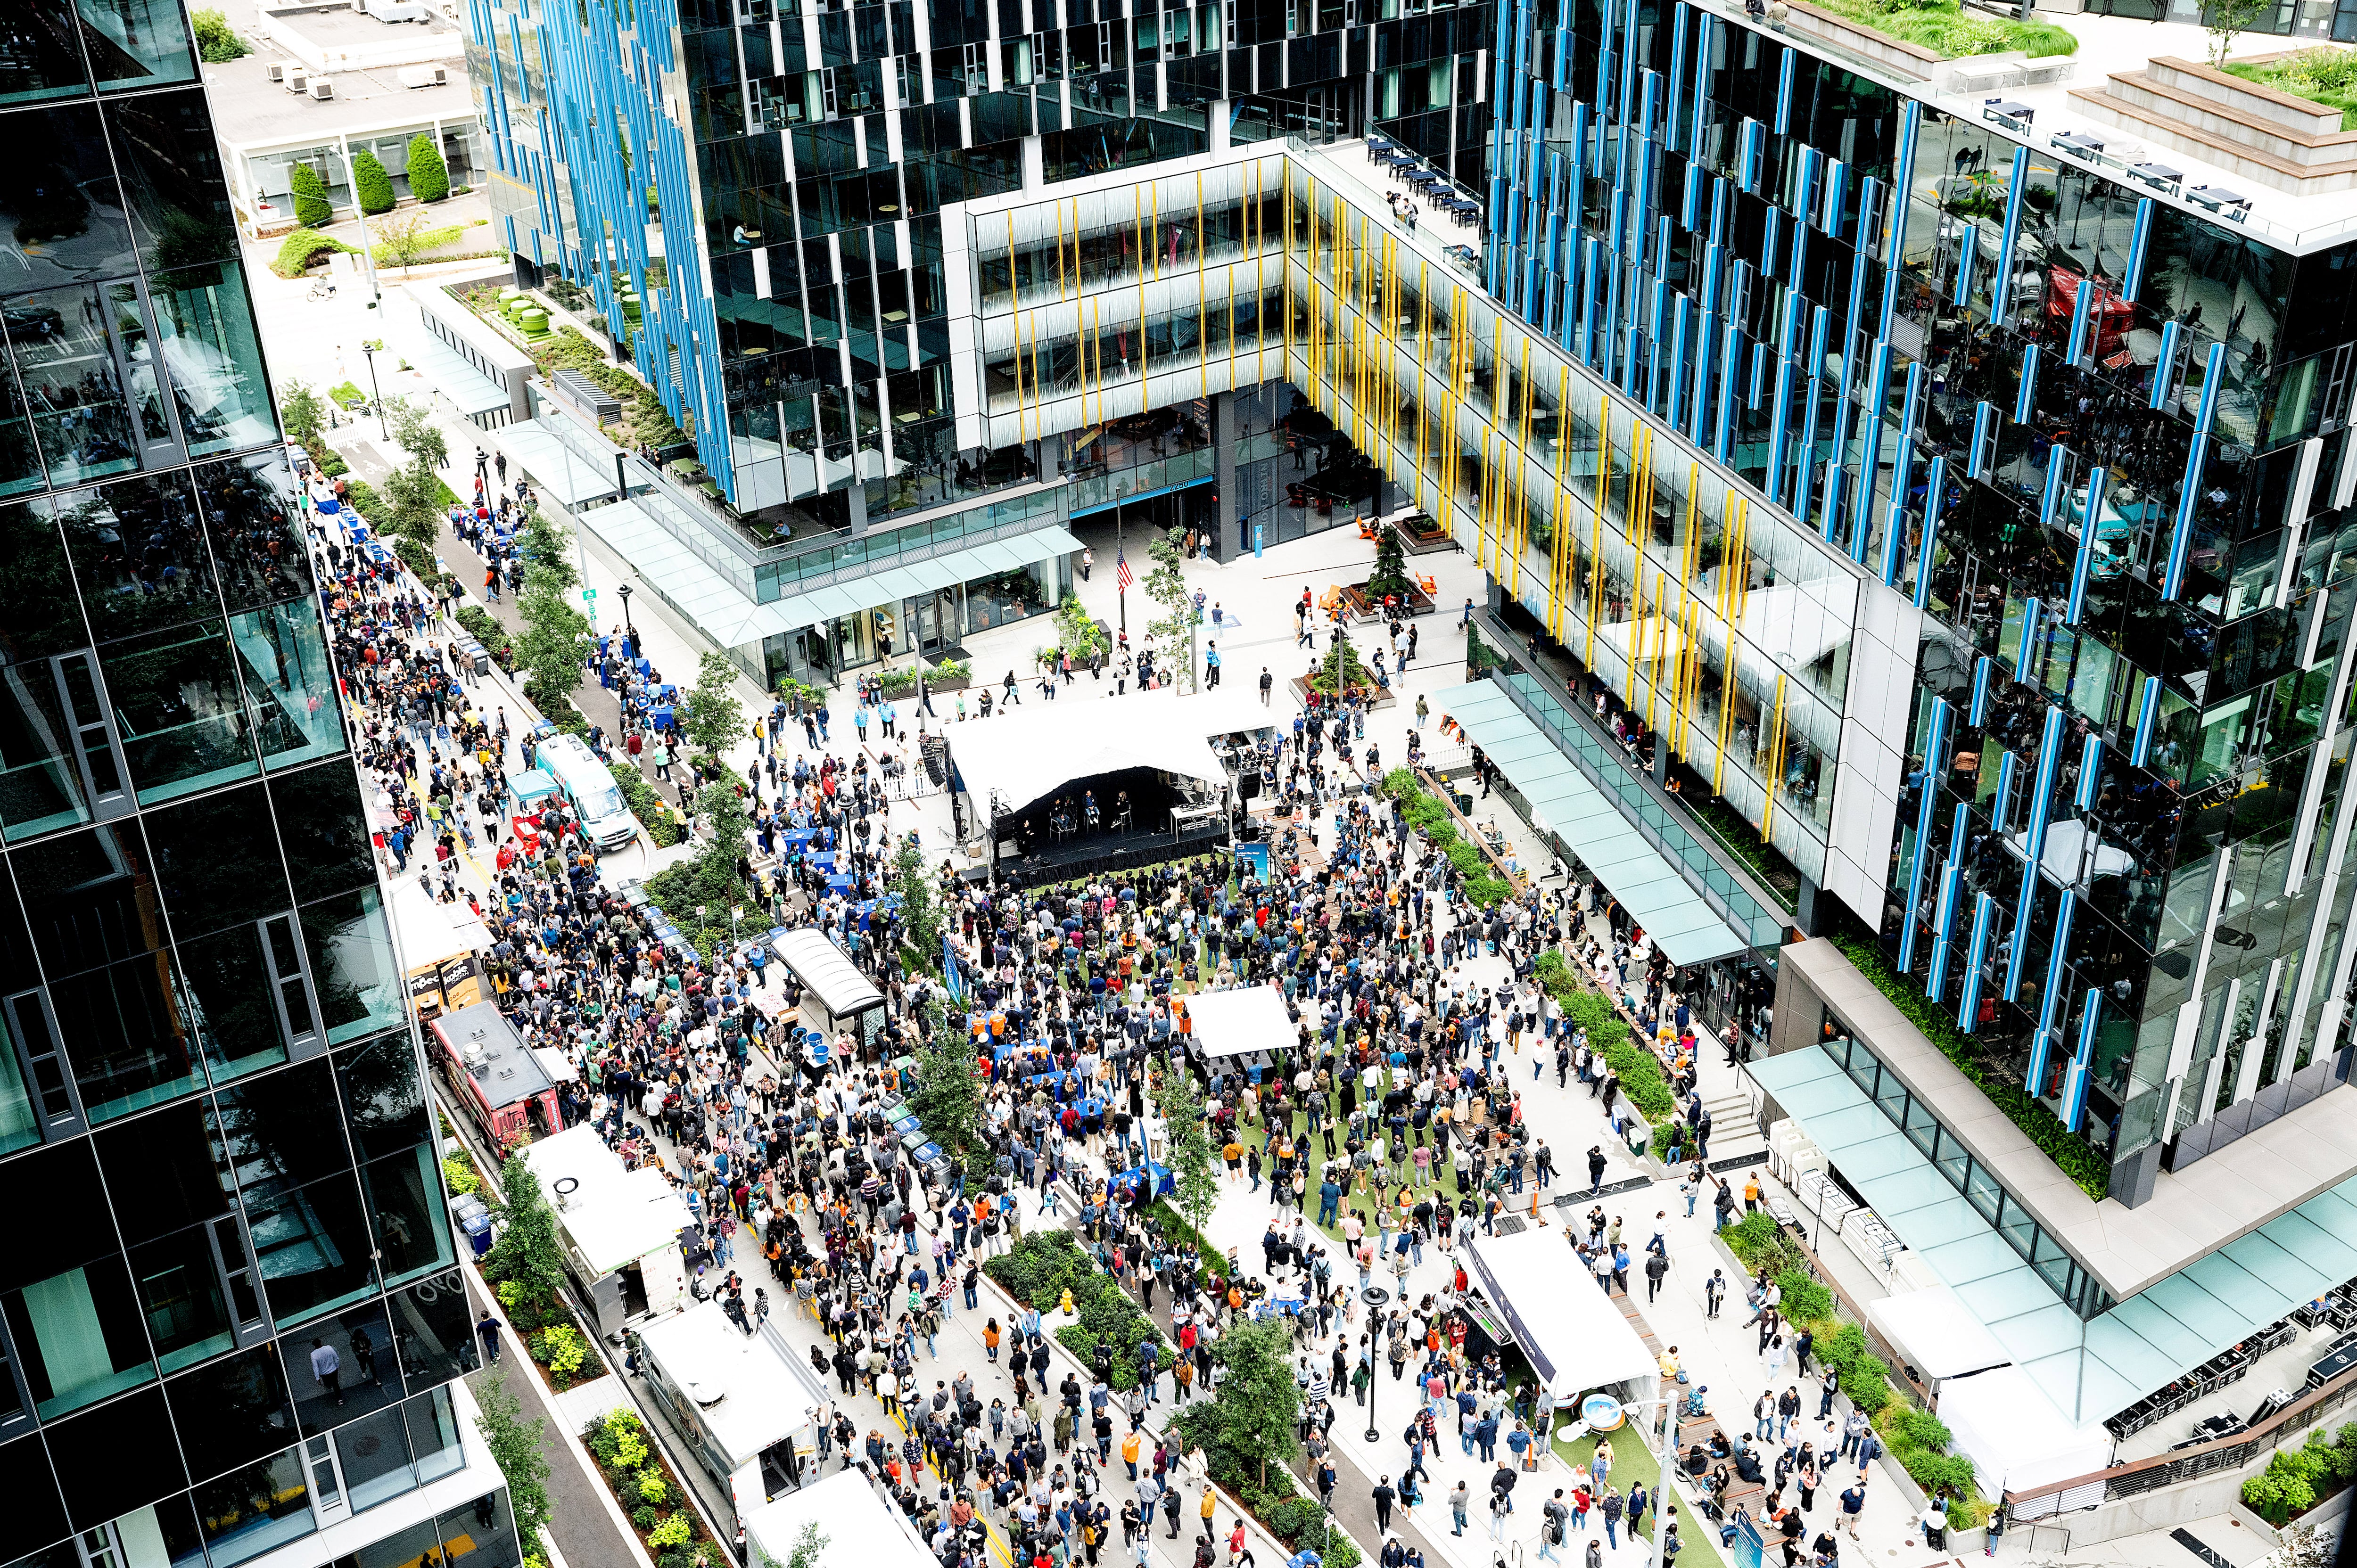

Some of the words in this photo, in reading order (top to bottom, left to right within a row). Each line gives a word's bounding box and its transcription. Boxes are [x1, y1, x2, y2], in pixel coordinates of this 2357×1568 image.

[1170, 480, 1188, 492] 2250
[846, 656, 870, 666] glassybaby
[451, 972, 470, 984] CHICKEN
[1519, 1330, 1536, 1357] Beverages
